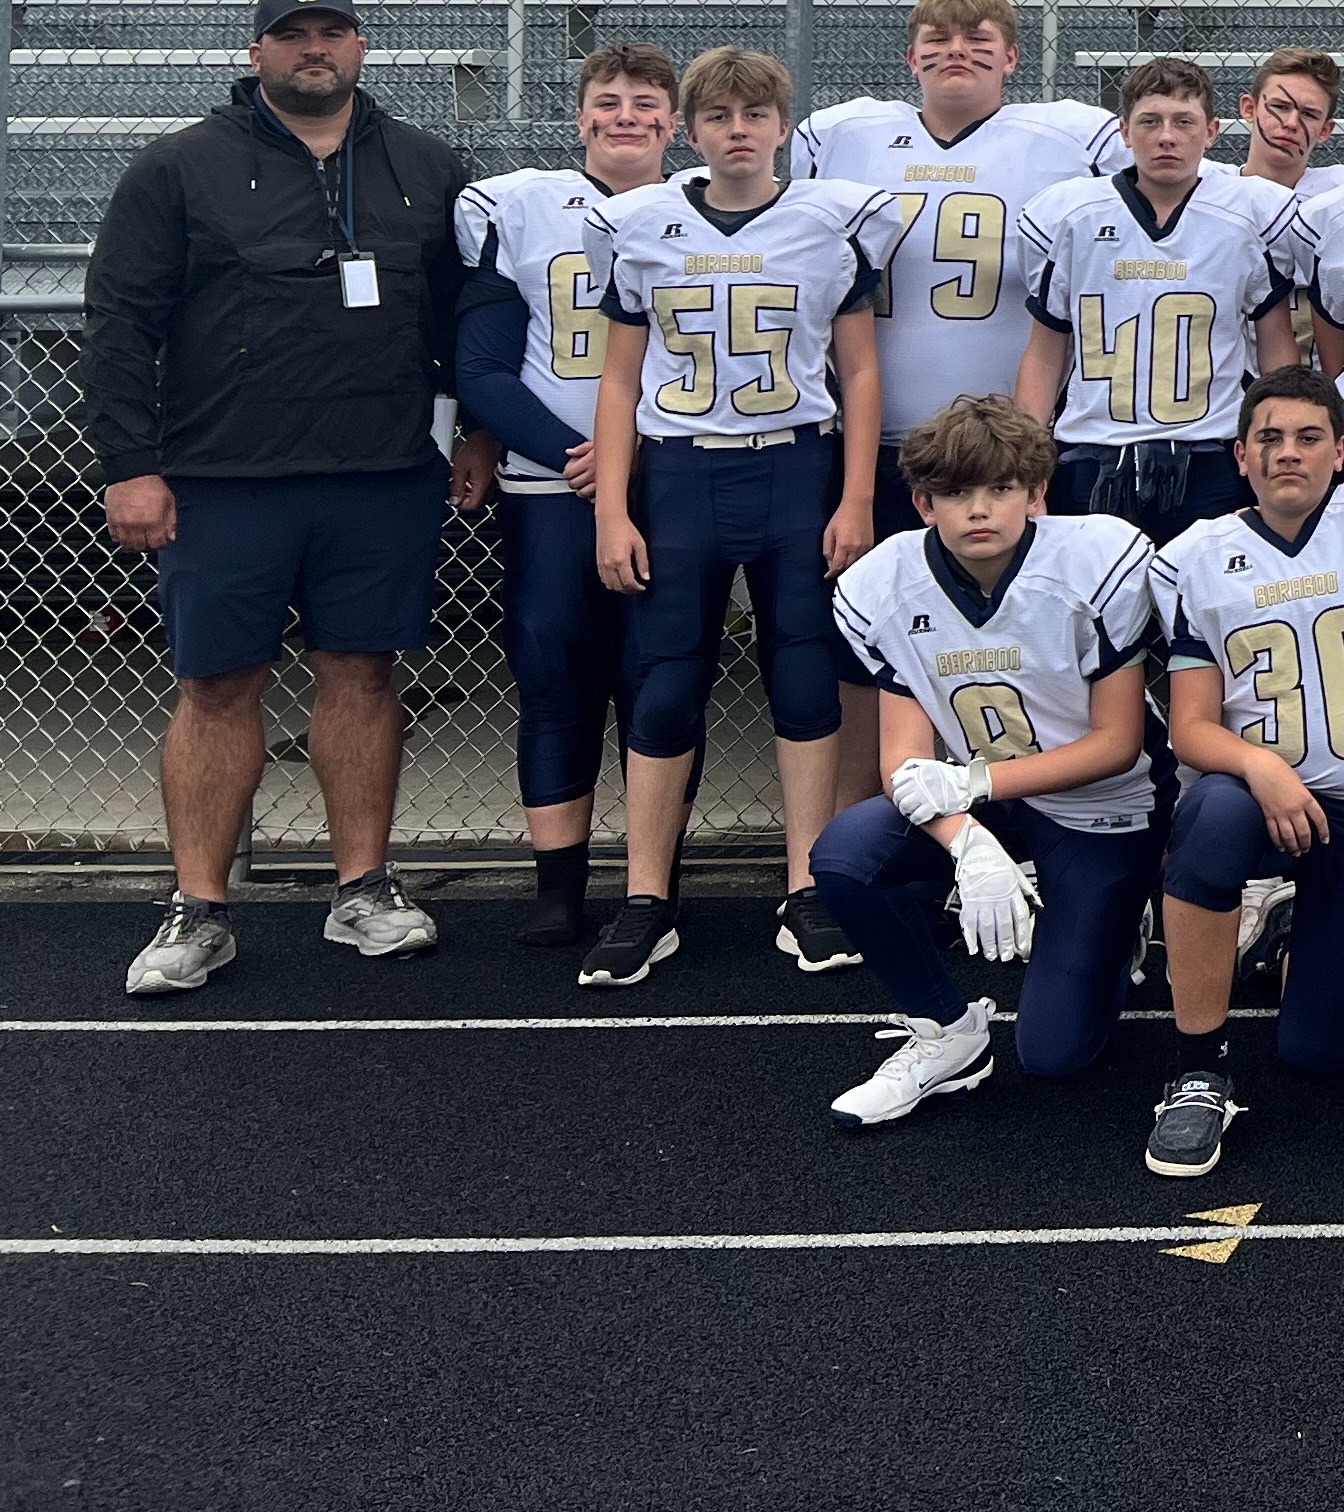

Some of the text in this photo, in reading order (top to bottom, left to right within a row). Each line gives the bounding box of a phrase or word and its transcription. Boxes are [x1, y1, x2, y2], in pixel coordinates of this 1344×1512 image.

[905, 164, 976, 183] BARABOO
[685, 254, 763, 277] BARABOO
[1115, 260, 1187, 280] BARABOO
[651, 284, 800, 417] 55
[1077, 292, 1216, 424] 40
[1254, 571, 1339, 609] BARABOO
[936, 647, 1021, 677] BARABOO
